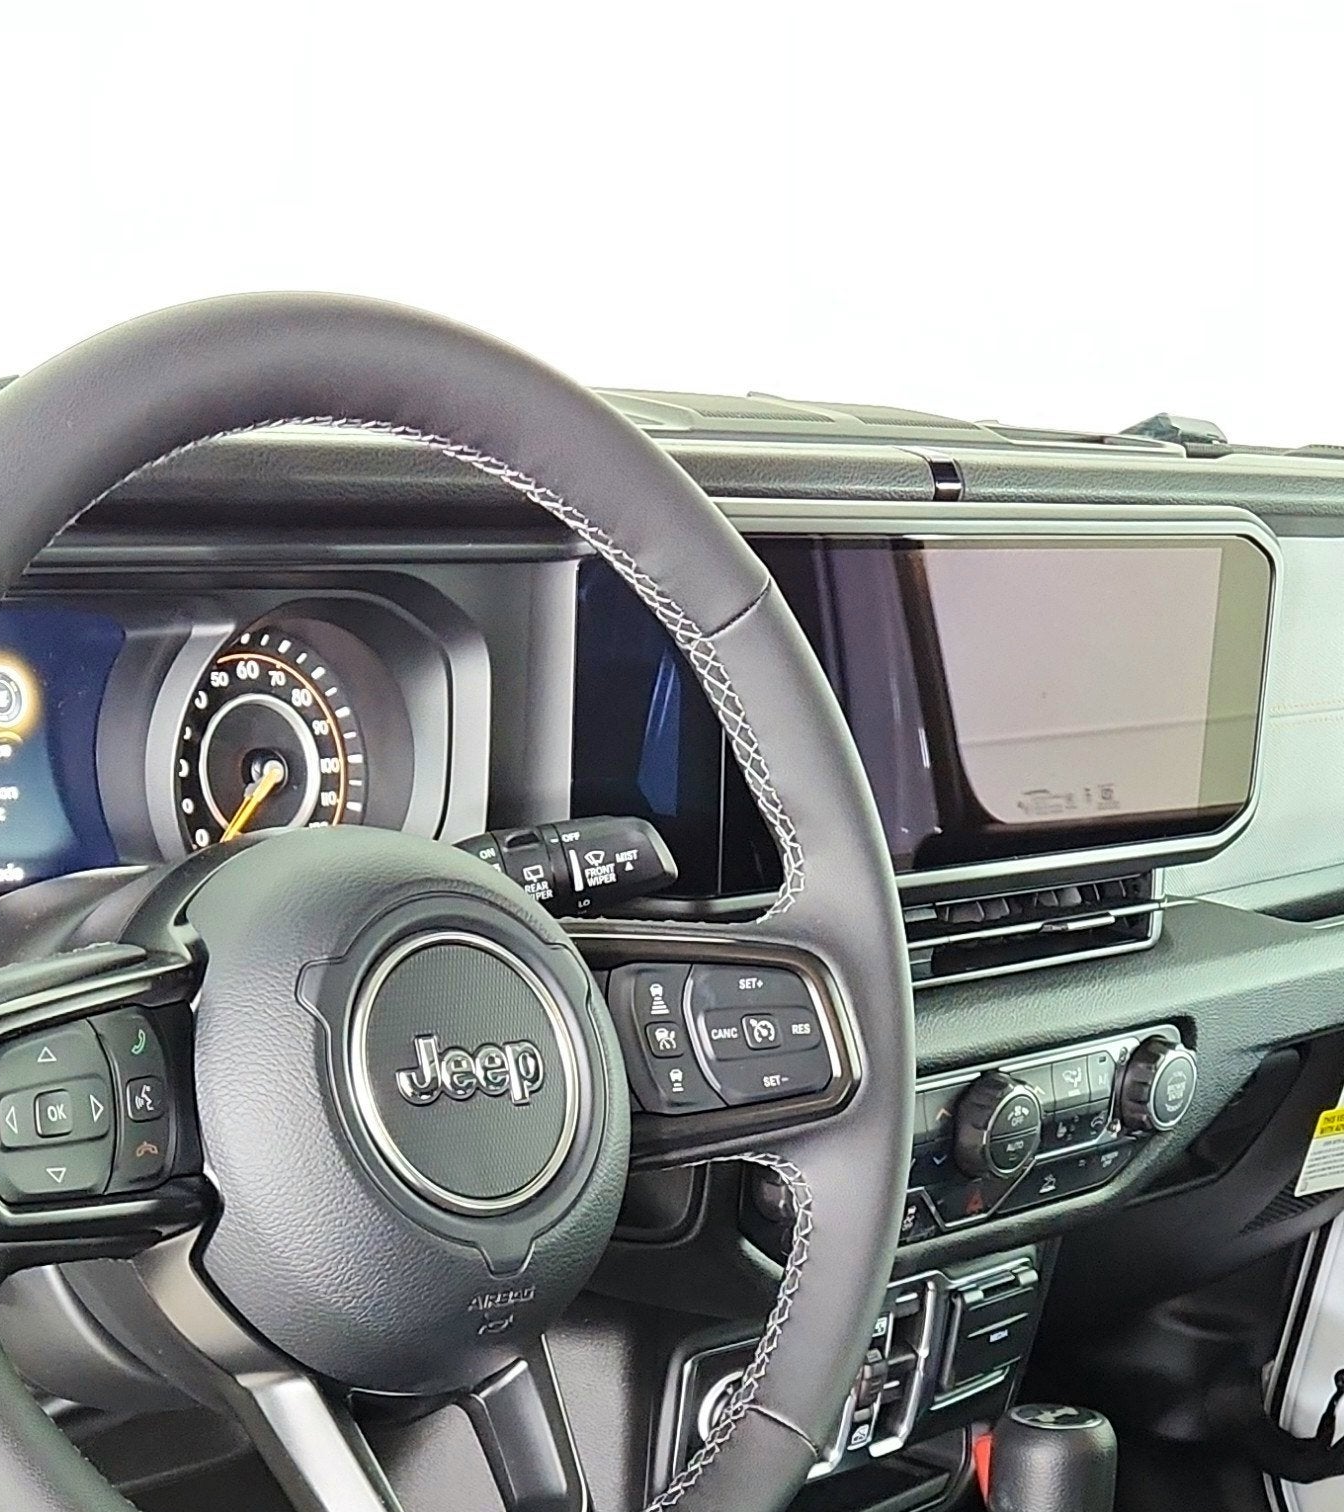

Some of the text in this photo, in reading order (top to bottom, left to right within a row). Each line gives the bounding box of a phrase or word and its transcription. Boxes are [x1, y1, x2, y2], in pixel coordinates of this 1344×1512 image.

[236, 660, 260, 680] 60
[210, 671, 229, 687] 50
[268, 670, 286, 686] 70
[291, 688, 312, 707] 80
[312, 720, 329, 736] 90
[321, 758, 339, 774] 100
[195, 828, 209, 847] 0
[561, 831, 580, 844] OFF
[479, 848, 496, 860] ON
[615, 849, 639, 863] MIST
[584, 863, 616, 878] FRONT
[524, 881, 549, 894] REAR
[586, 873, 617, 888] WIPER
[532, 889, 553, 901] IPER
[577, 899, 591, 908] LO
[711, 1028, 738, 1040] CANC
[791, 1023, 811, 1035] RES
[395, 1033, 544, 1107] Jeep
[47, 1104, 67, 1122] OK
